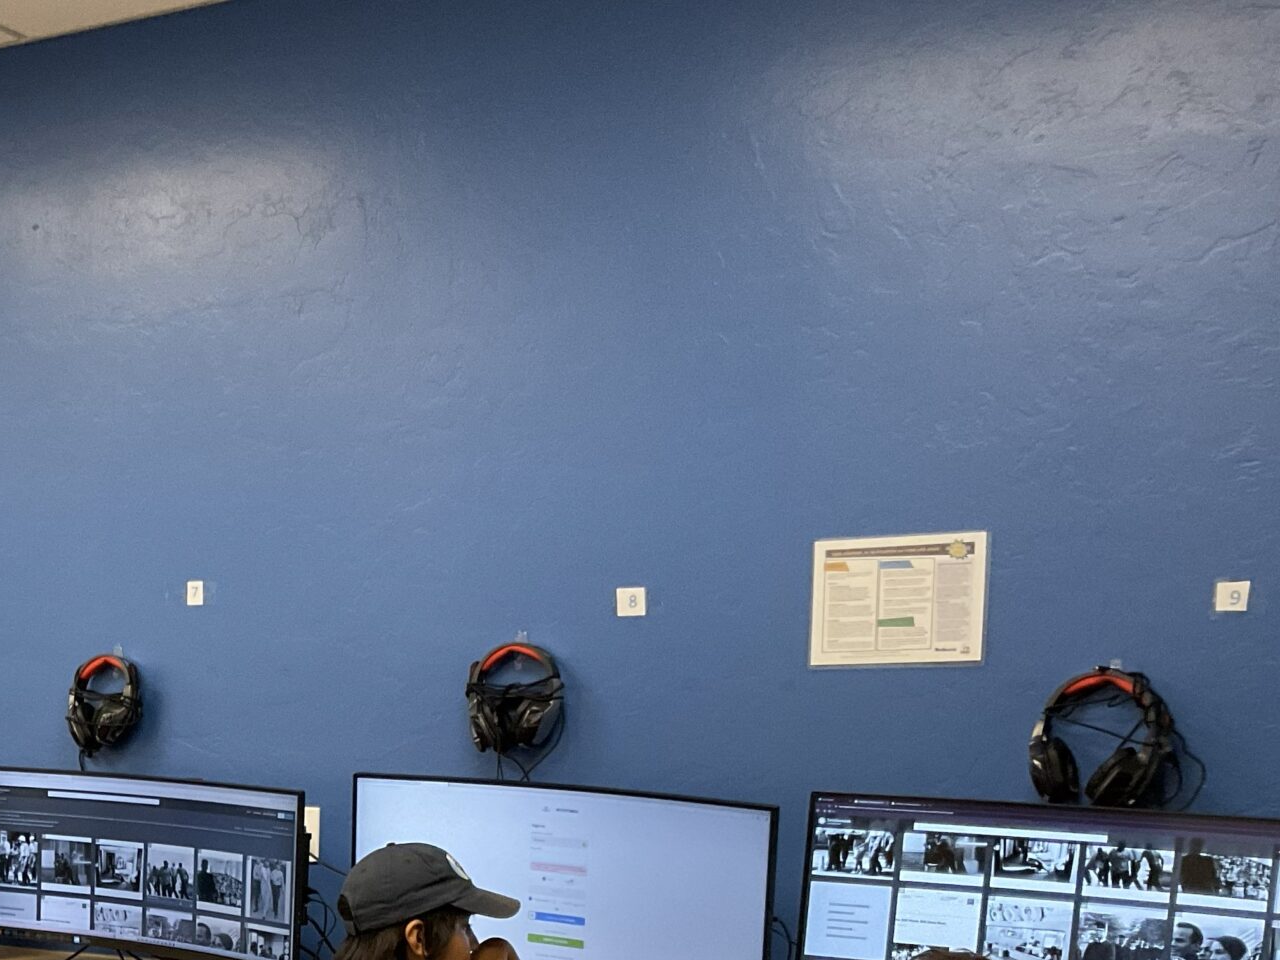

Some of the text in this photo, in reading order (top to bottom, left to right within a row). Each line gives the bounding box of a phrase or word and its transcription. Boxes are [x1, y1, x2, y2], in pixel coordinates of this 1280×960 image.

[192, 587, 199, 598] 7
[1230, 590, 1241, 605] 9
[628, 595, 638, 608] 8
